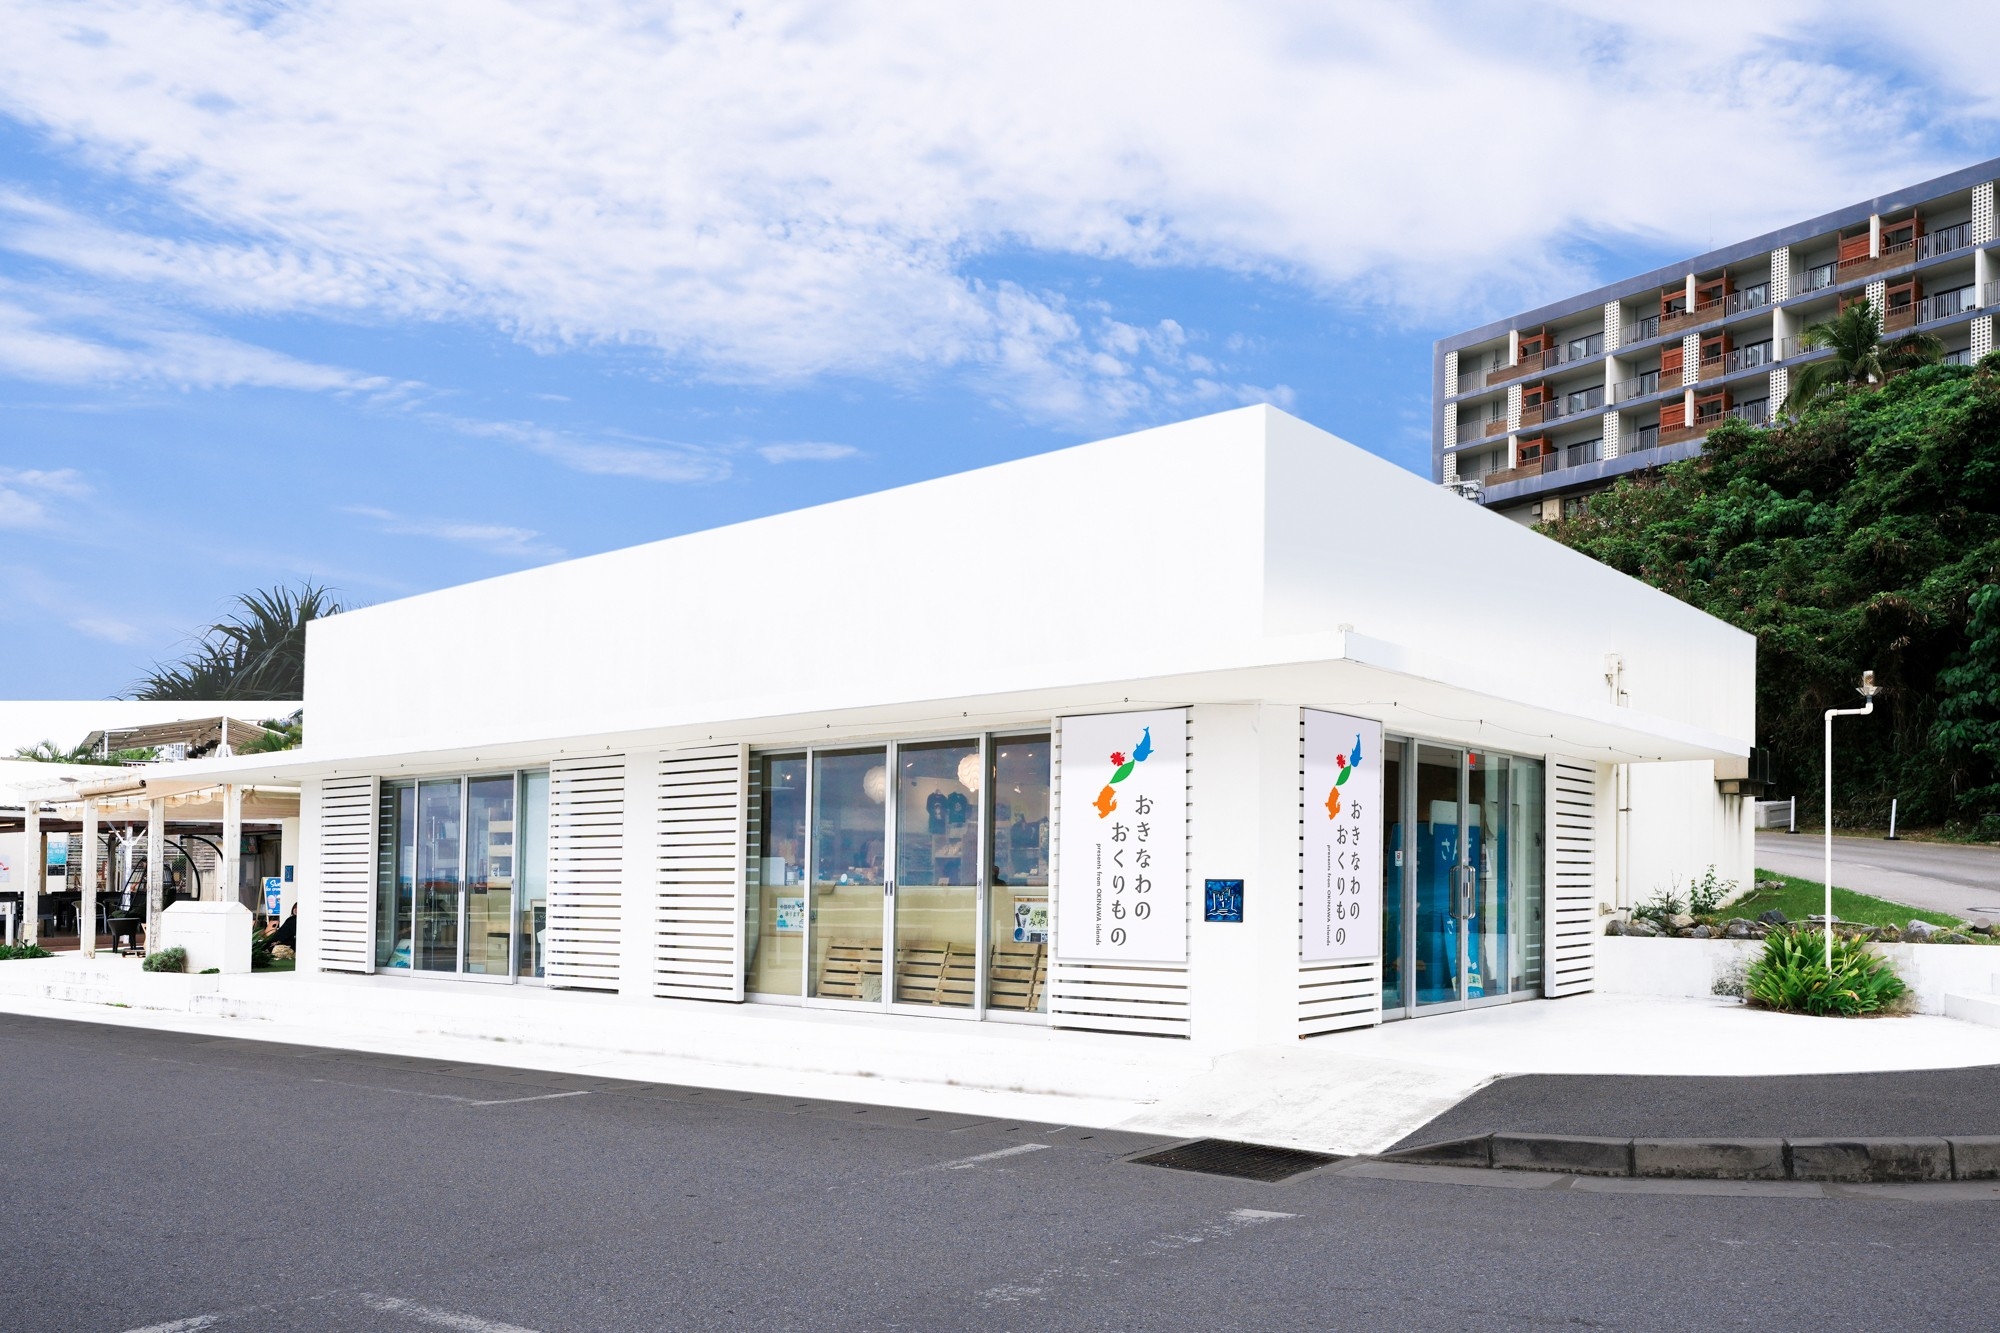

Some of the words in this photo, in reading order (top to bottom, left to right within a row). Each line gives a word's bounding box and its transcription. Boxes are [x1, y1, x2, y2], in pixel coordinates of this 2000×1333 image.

[1110, 822, 1130, 947] おくりもの
[1134, 794, 1154, 921] おきなわの
[1335, 824, 1348, 946] おくりもの
[1350, 799, 1362, 920] おきなわの
